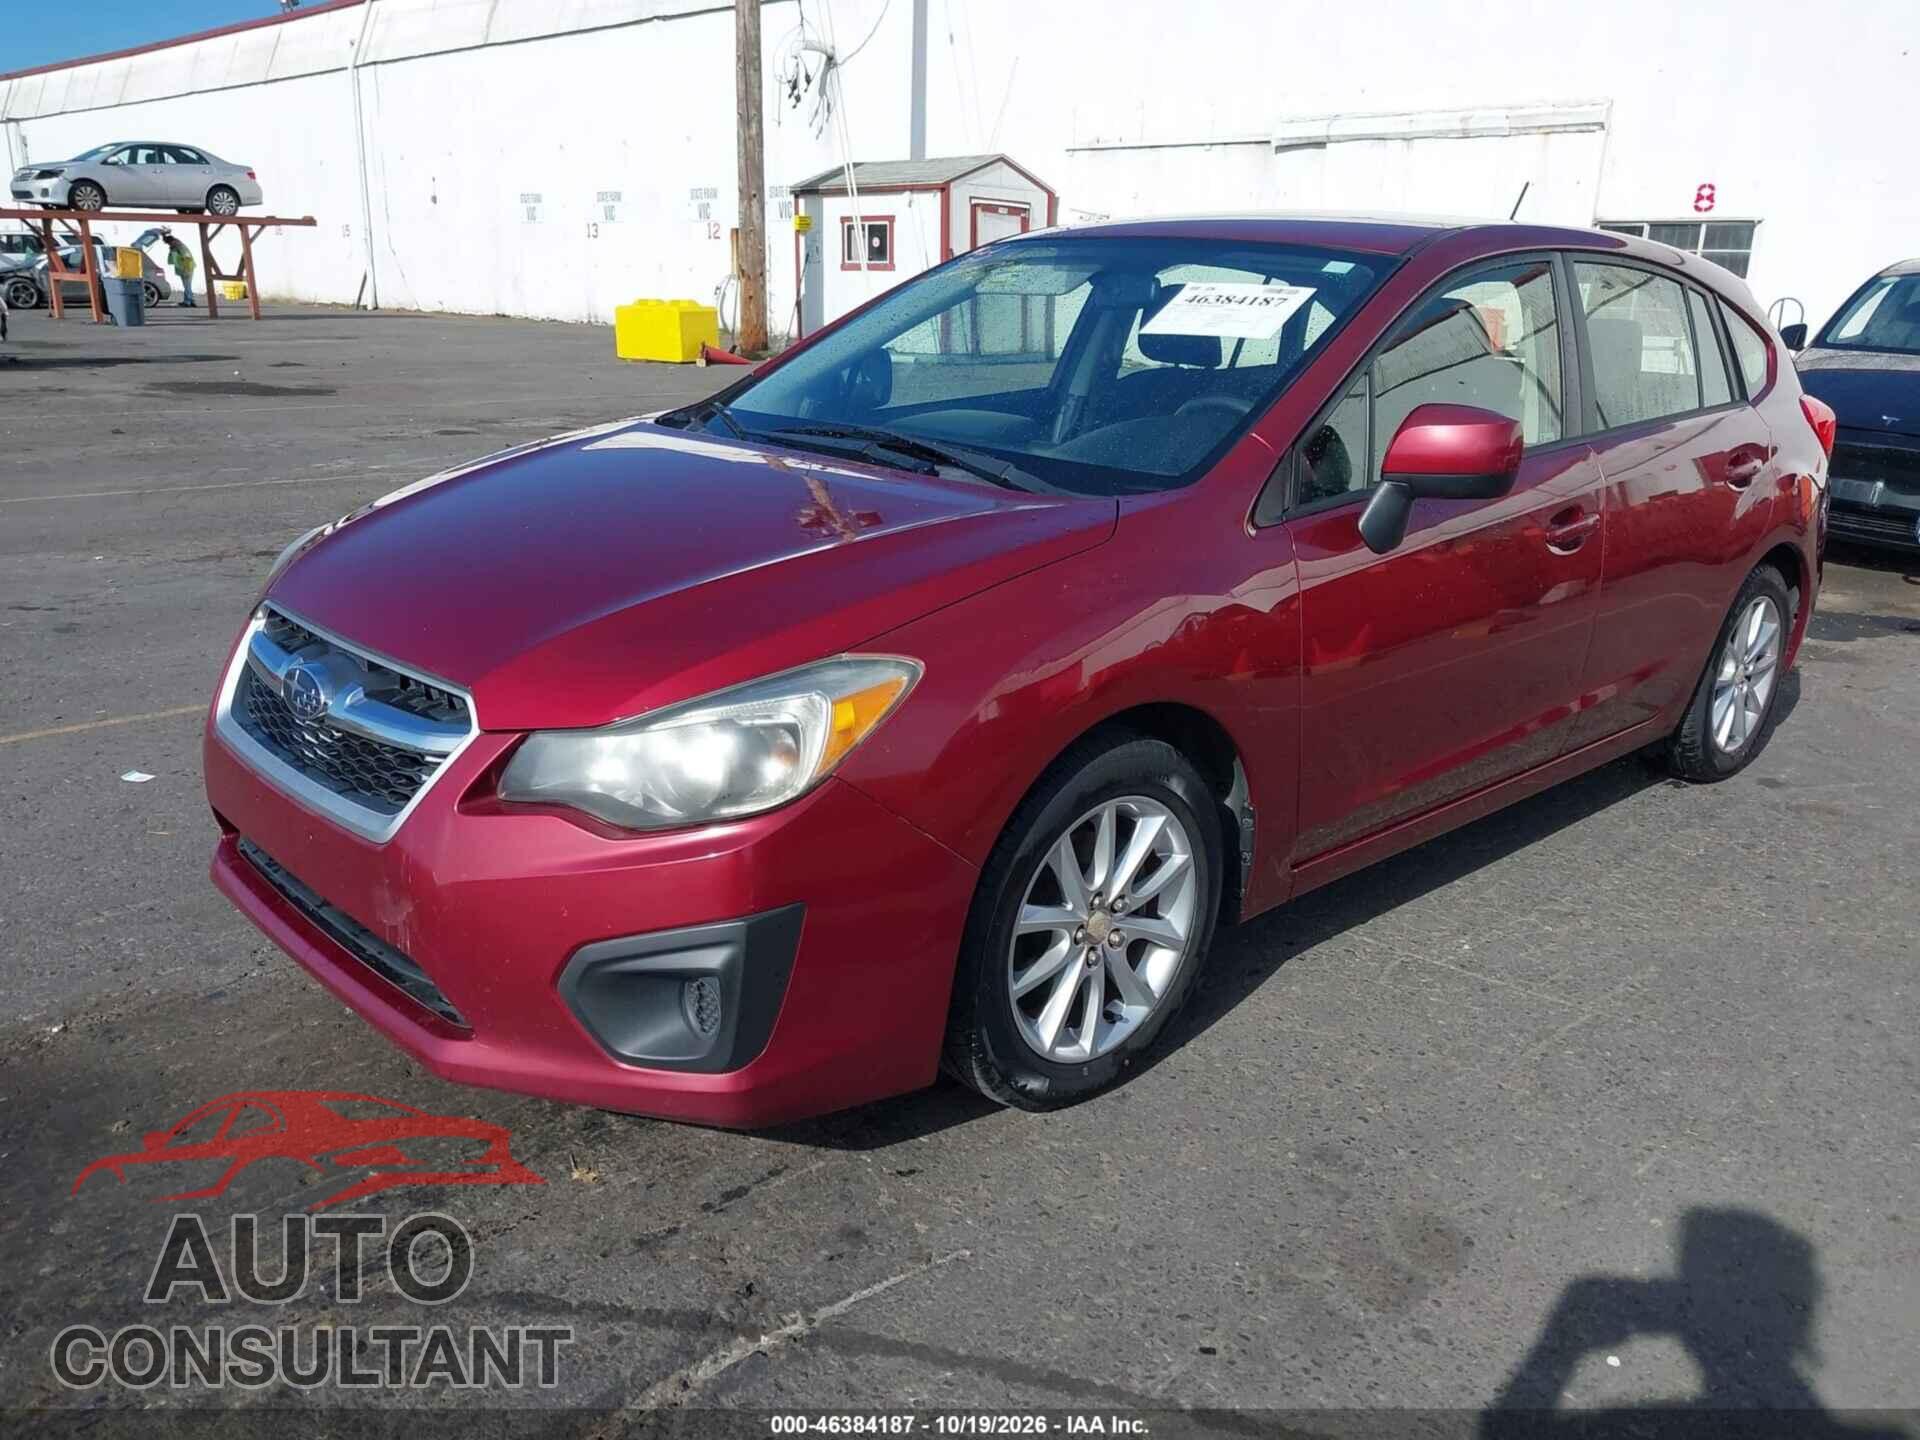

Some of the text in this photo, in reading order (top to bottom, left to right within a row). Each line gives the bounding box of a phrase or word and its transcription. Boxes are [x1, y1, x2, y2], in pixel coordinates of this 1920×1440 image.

[1693, 183, 1716, 213] 8
[604, 205, 616, 221] VIC
[697, 202, 711, 220] VIC
[778, 200, 792, 219] VIC
[586, 222, 599, 239] 13
[707, 222, 721, 239] 12
[1185, 295, 1288, 306] 46384187
